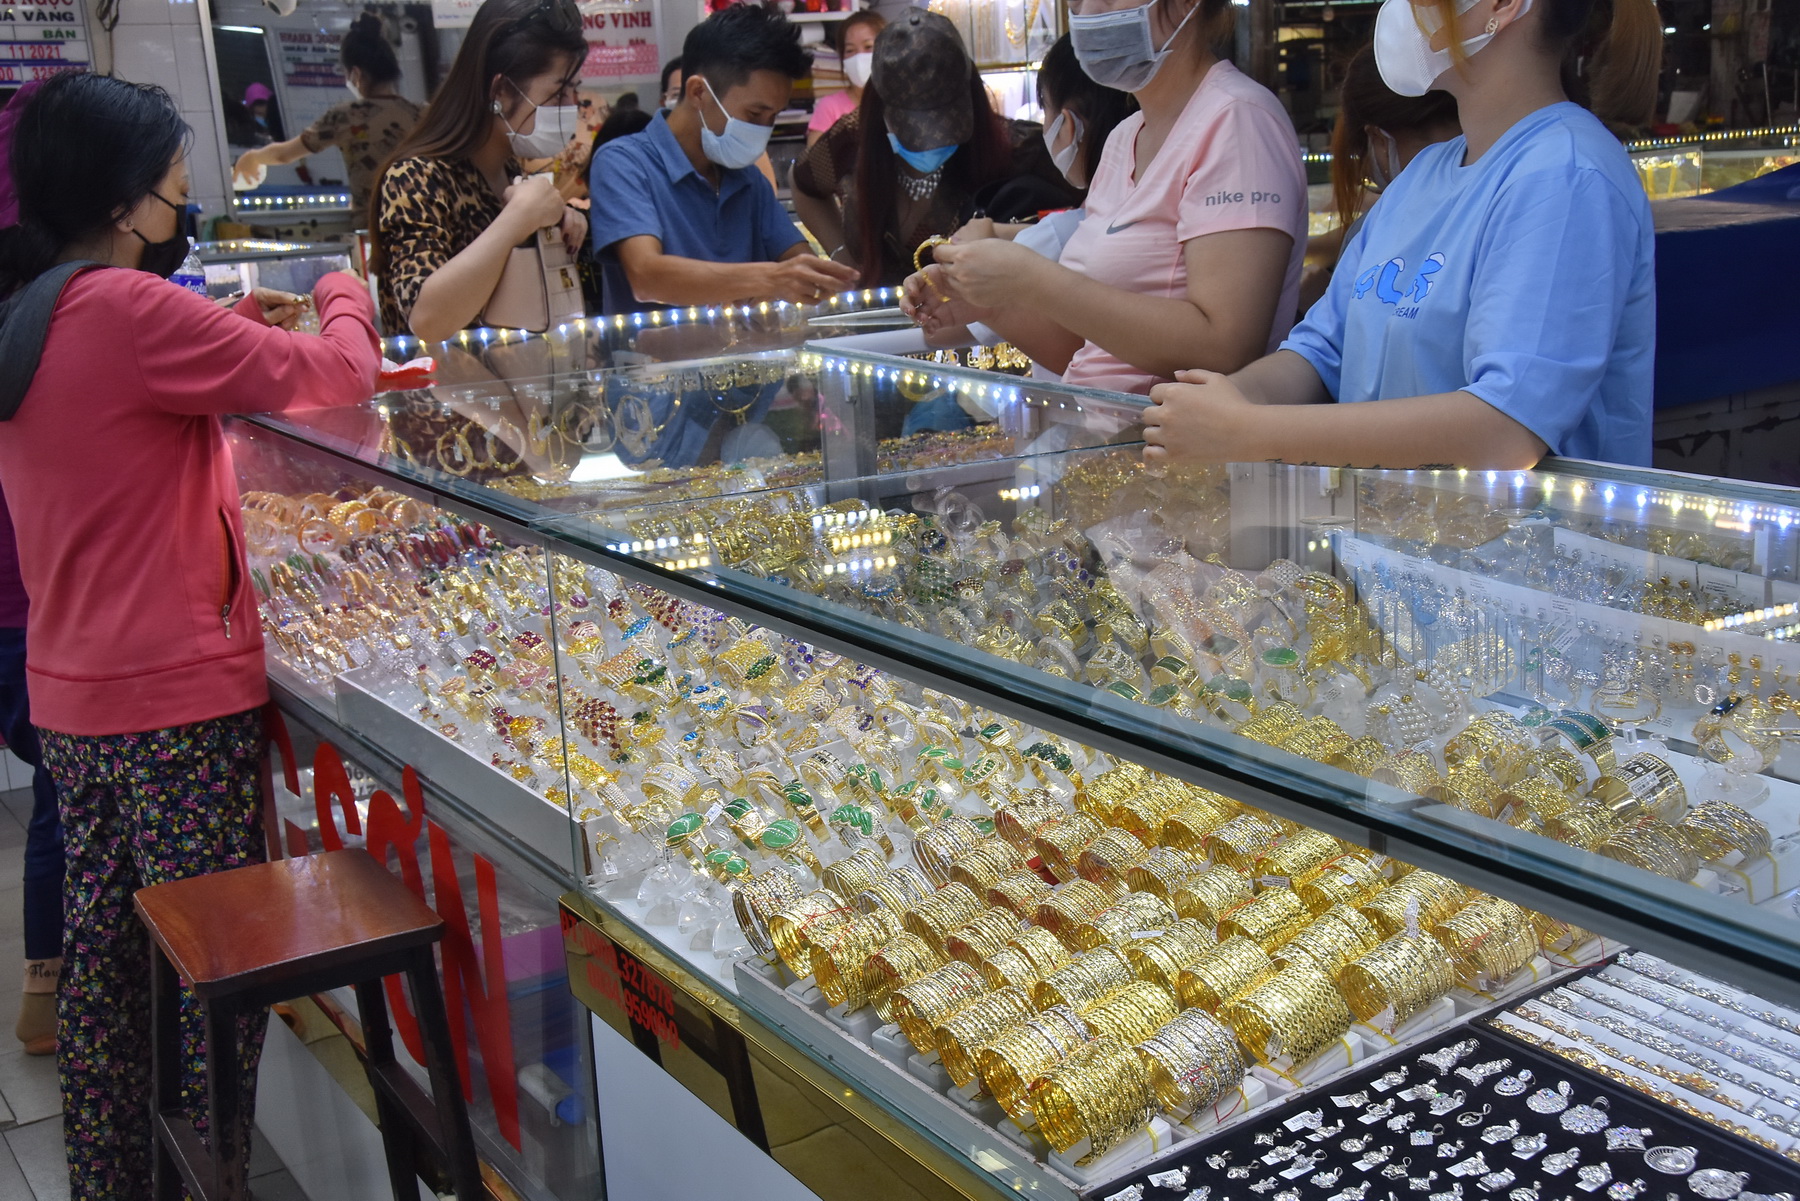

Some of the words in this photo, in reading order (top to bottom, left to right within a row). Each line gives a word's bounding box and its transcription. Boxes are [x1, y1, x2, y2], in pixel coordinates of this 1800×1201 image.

[22, 9, 75, 21] VÀNG
[610, 11, 652, 28] VINH
[43, 28, 76, 38] BÁN
[29, 45, 61, 59] 2021
[1205, 191, 1244, 206] nike
[1250, 191, 1281, 205] pro
